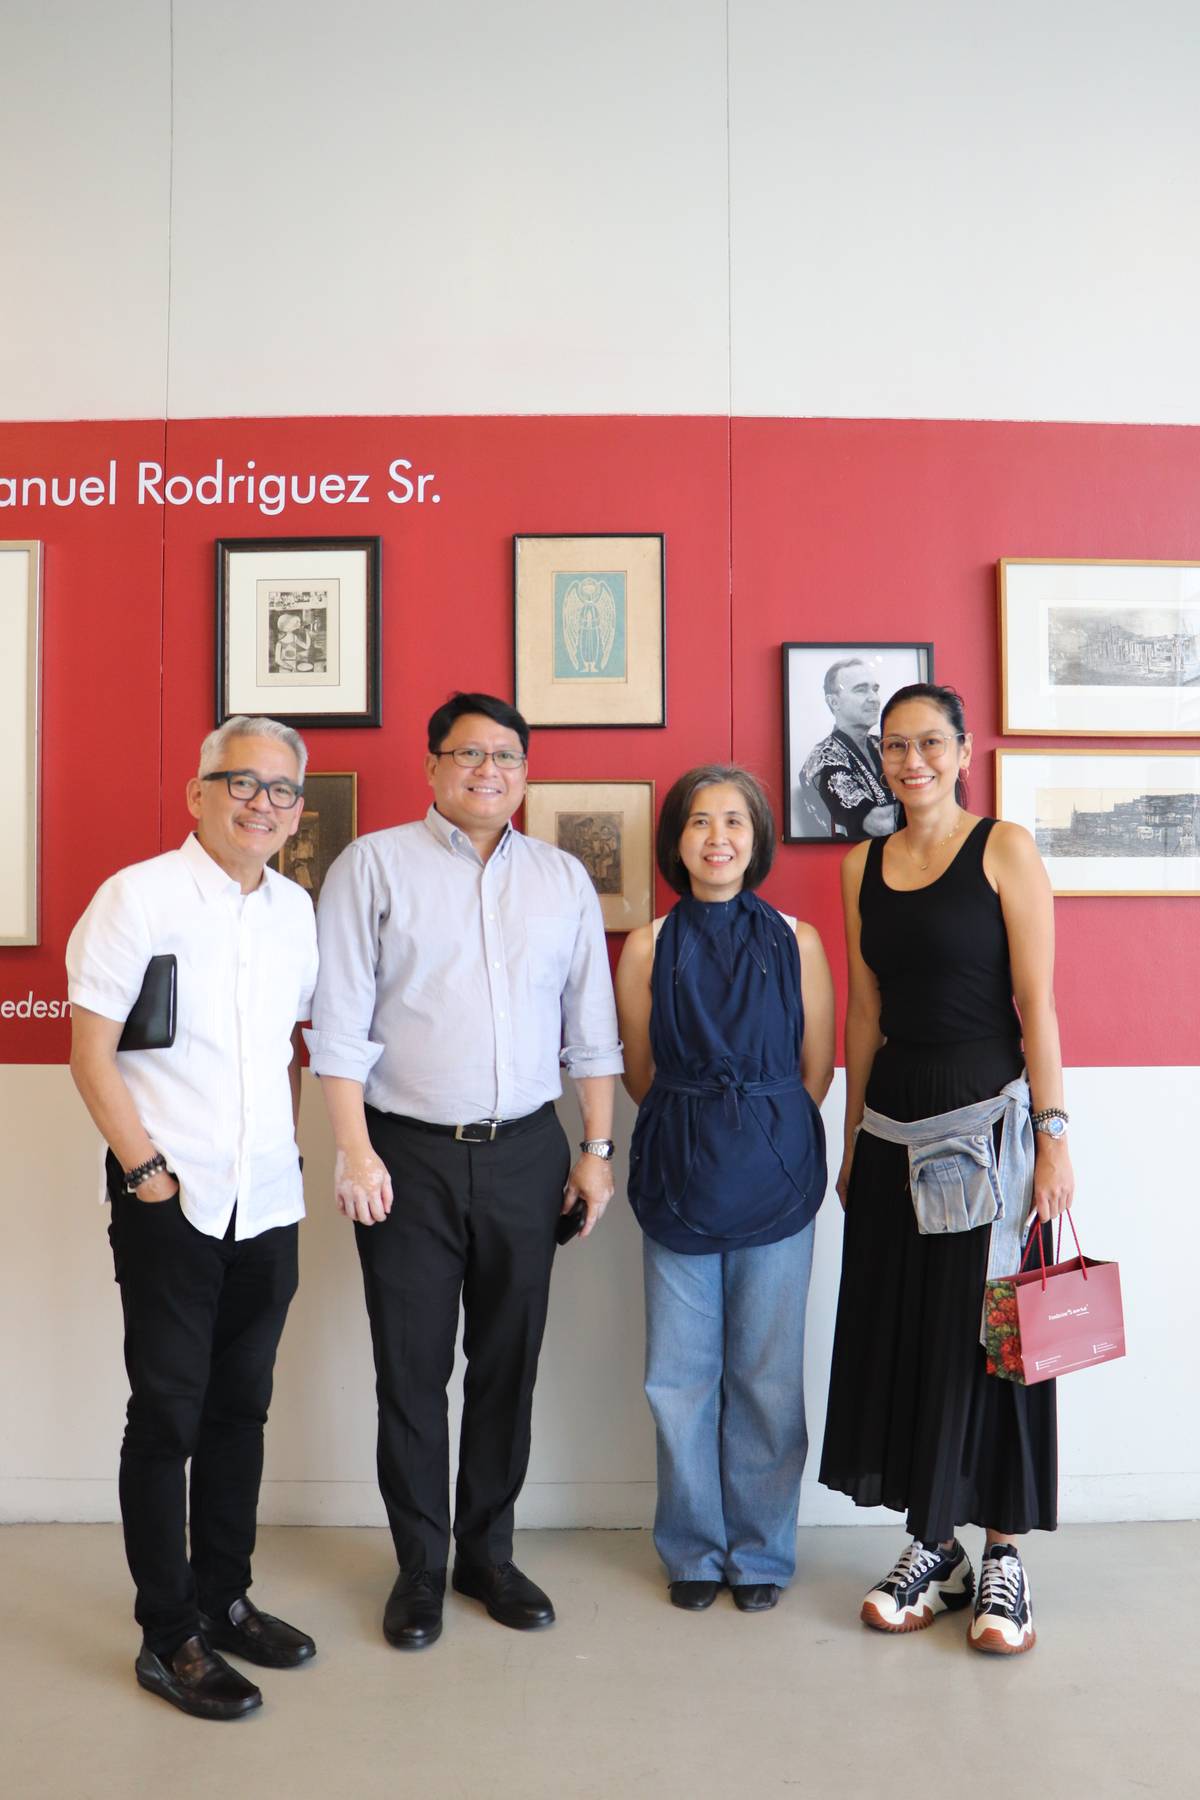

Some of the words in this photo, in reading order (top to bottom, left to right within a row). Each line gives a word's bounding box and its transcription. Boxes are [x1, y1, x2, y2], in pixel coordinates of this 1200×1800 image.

[0, 459, 117, 507] anuel
[138, 458, 370, 516] Rodriguez
[387, 458, 441, 504] Sr.
